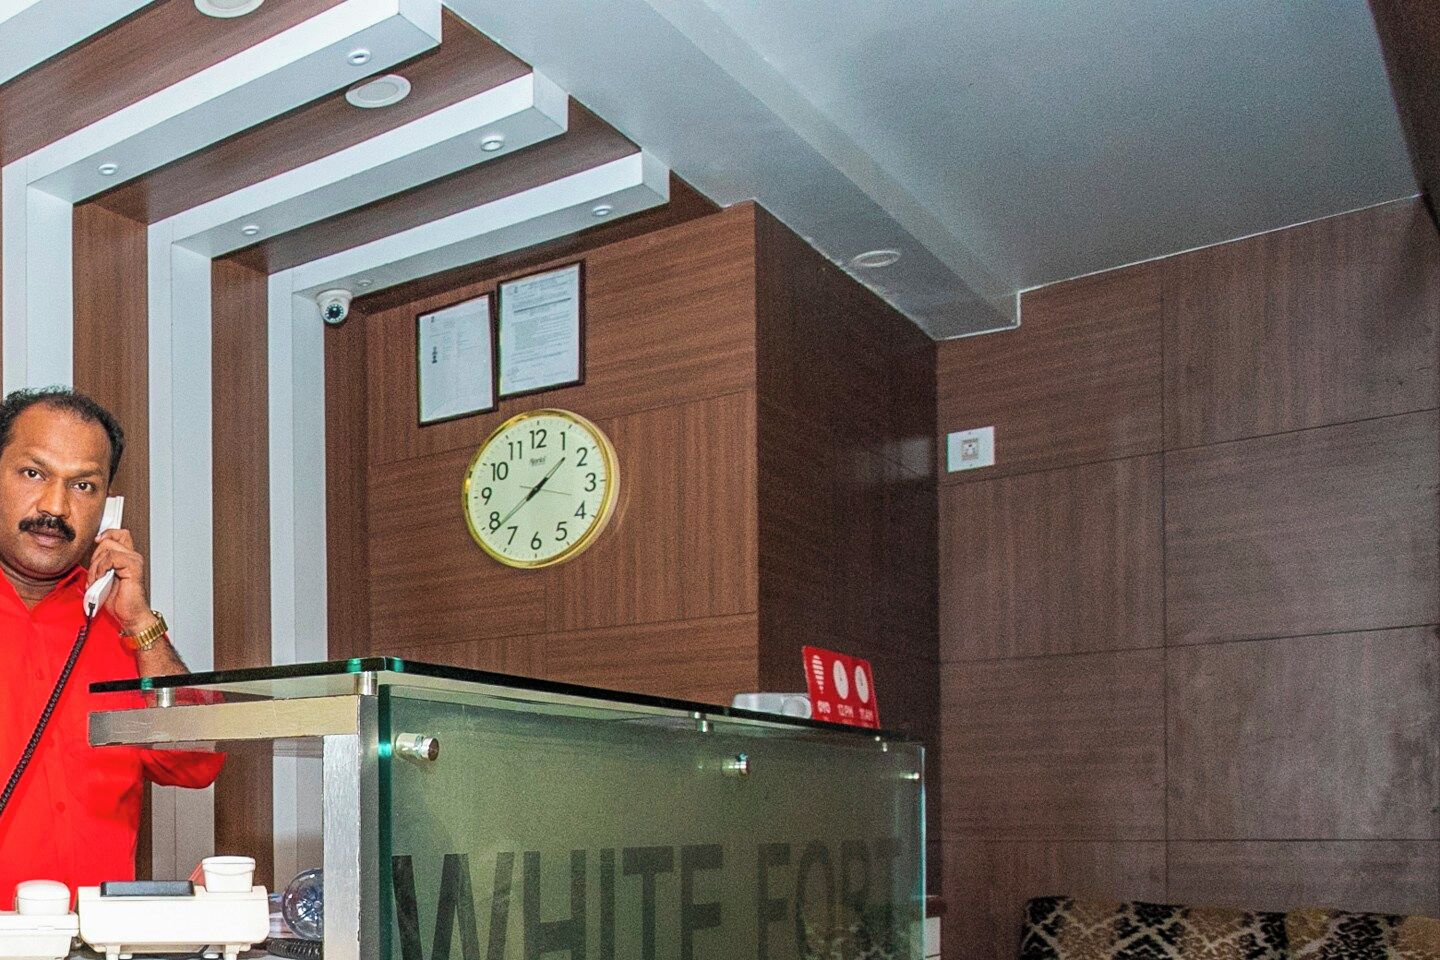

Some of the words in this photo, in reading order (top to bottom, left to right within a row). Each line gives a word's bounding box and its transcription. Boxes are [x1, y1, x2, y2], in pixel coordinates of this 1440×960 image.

[529, 429, 547, 449] 12
[560, 431, 566, 450] 1
[509, 441, 523, 461] 11
[576, 447, 588, 467] 2
[491, 461, 508, 481] 10
[585, 473, 596, 492] 3
[482, 487, 492, 505] 9
[574, 502, 587, 519] 4
[488, 511, 500, 530] 8
[507, 525, 518, 545] 7
[531, 531, 542, 550] 6
[555, 521, 568, 541] 5
